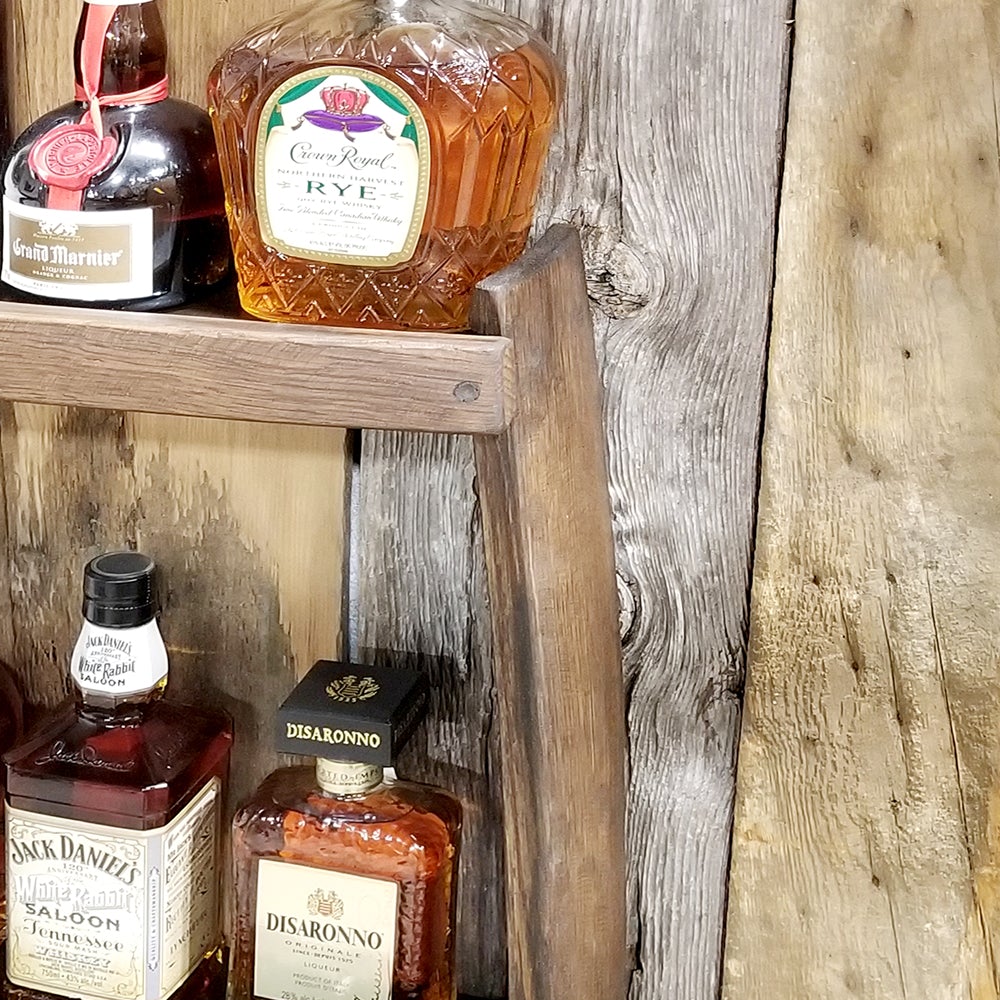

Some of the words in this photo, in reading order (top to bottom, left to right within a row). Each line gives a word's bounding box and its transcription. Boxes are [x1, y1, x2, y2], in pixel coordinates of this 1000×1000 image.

[290, 142, 337, 164] Crown
[327, 146, 395, 170] Royal
[306, 180, 377, 201] RYE
[12, 237, 49, 263] Grand
[49, 245, 124, 267] Marnier
[41, 265, 75, 275] LIQUEUR
[286, 722, 381, 748] DISARONNO
[10, 837, 58, 865] JACK
[60, 834, 141, 885] DANIEL'S
[25, 902, 120, 932] SALOON
[266, 912, 382, 950] DISARONNO
[22, 918, 124, 953] Tennessee
[303, 961, 341, 972] LIQUEUR
